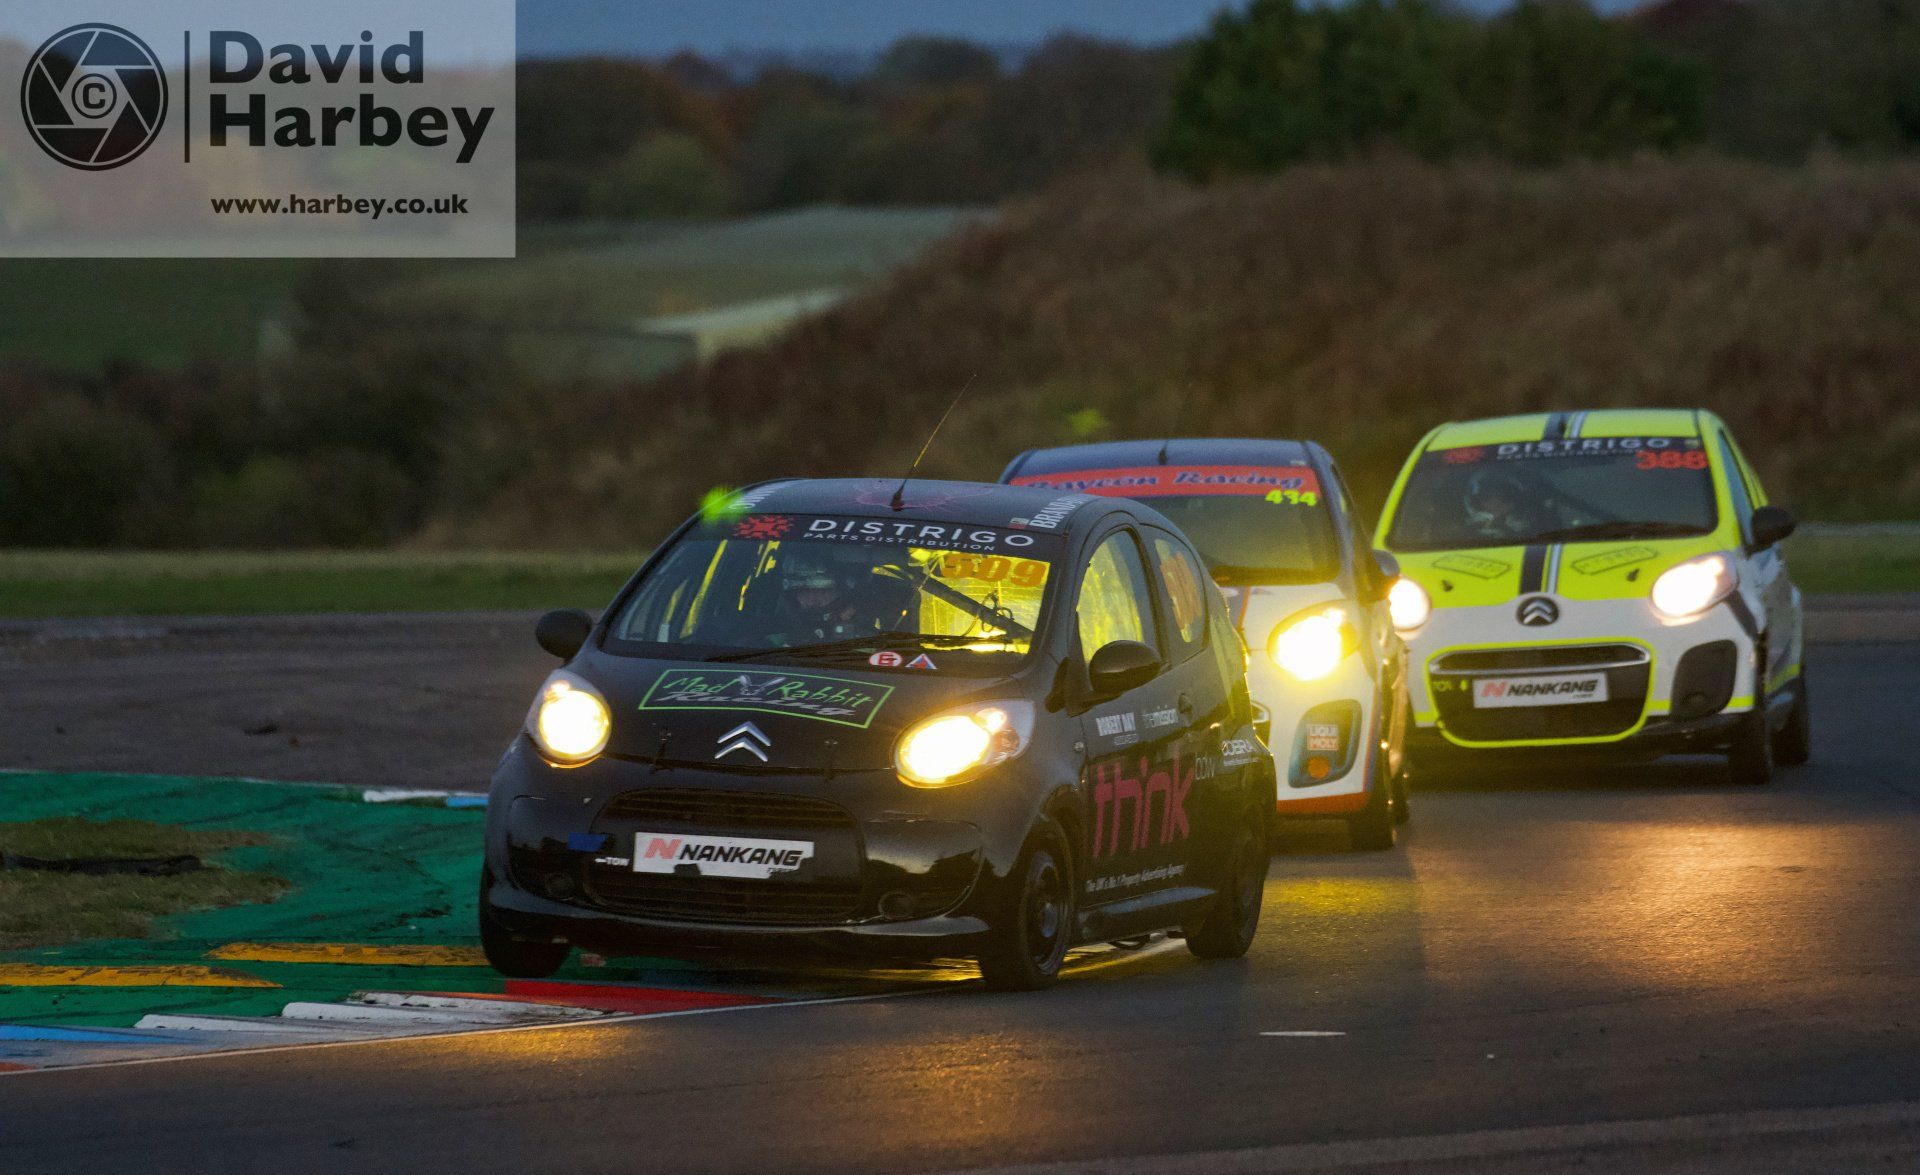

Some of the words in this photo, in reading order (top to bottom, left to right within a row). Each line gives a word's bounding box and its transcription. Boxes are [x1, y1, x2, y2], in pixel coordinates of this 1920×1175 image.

[1498, 438, 1671, 454] DISTRIGO
[1173, 472, 1304, 489] Racing
[1265, 489, 1318, 507] 434
[803, 533, 858, 541] PARTS
[865, 536, 996, 551] DISTRIBUTION
[808, 519, 1034, 547] DISTRIGO
[941, 553, 1047, 588] 509
[663, 676, 743, 693] Mad
[766, 681, 874, 708] Rabbit
[1507, 679, 1599, 696] NANKANG
[1092, 752, 1195, 858] think
[680, 845, 803, 866] NANKANG
